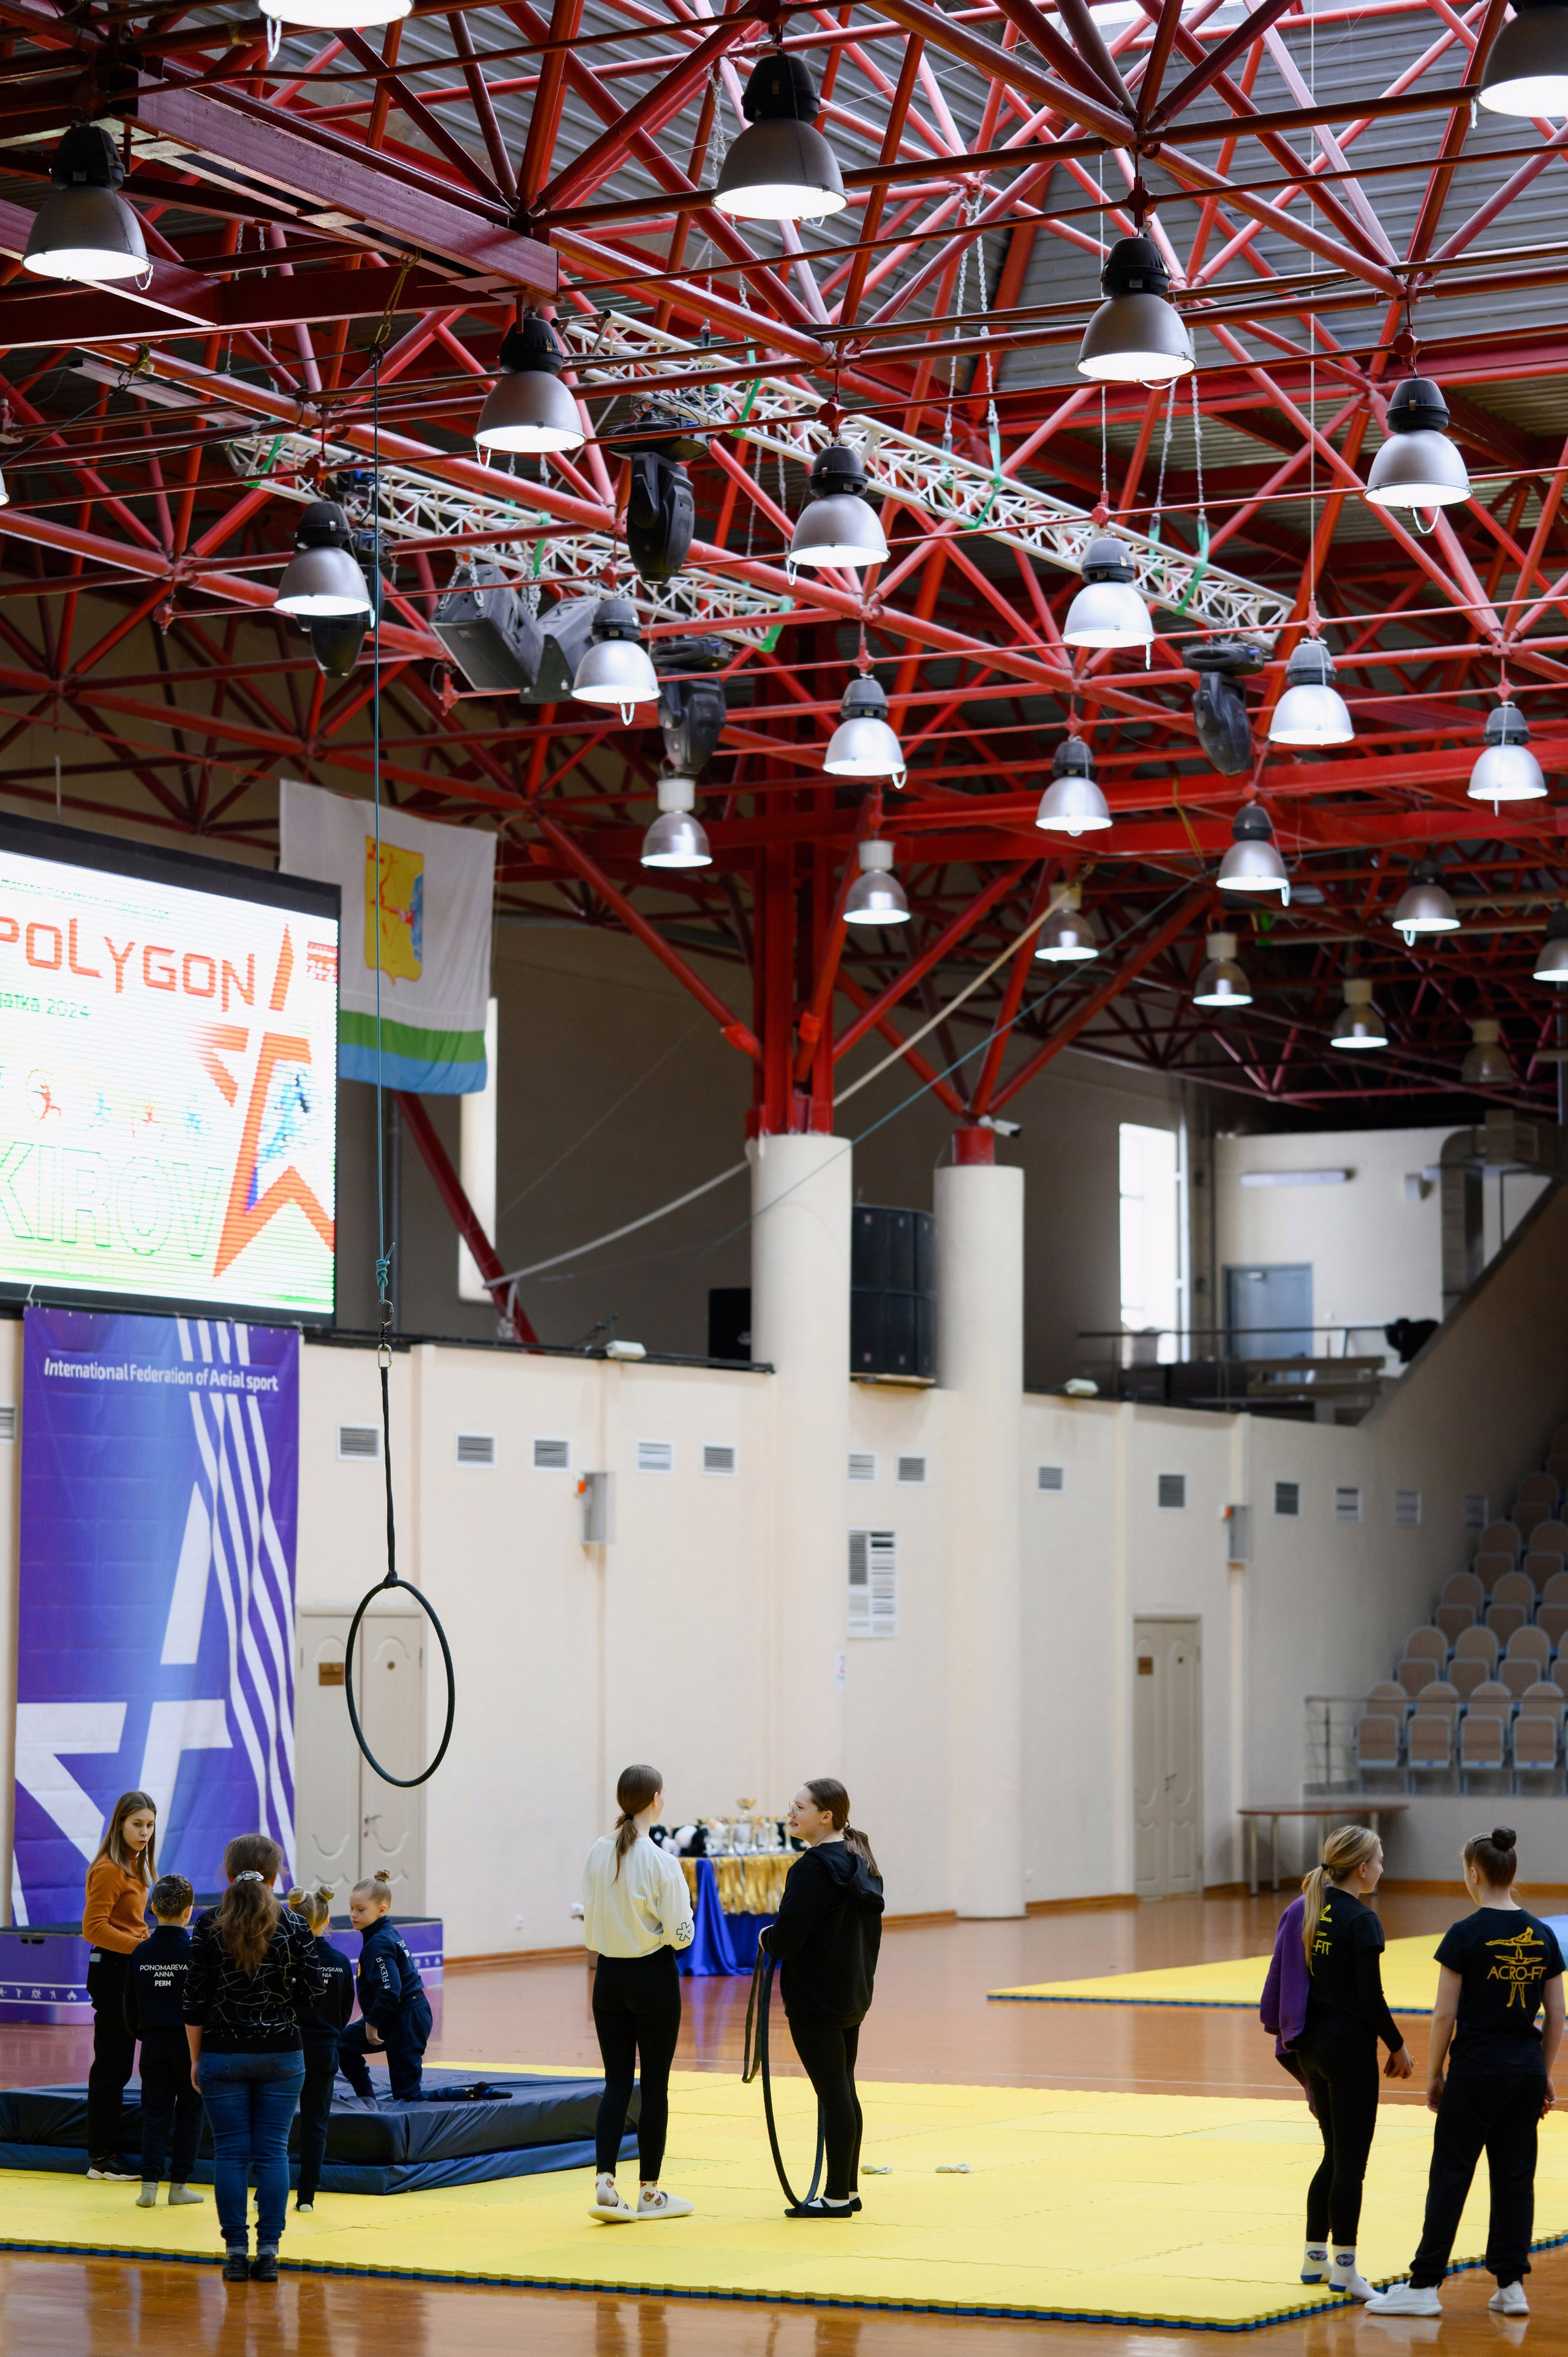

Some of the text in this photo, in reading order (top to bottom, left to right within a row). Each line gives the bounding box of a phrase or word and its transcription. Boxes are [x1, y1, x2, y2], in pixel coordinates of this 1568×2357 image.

[47, 997, 91, 1020] 2024
[44, 1357, 129, 1381] International
[129, 1363, 194, 1386] Federation
[195, 1367, 209, 1386] of
[246, 1375, 279, 1394] sport
